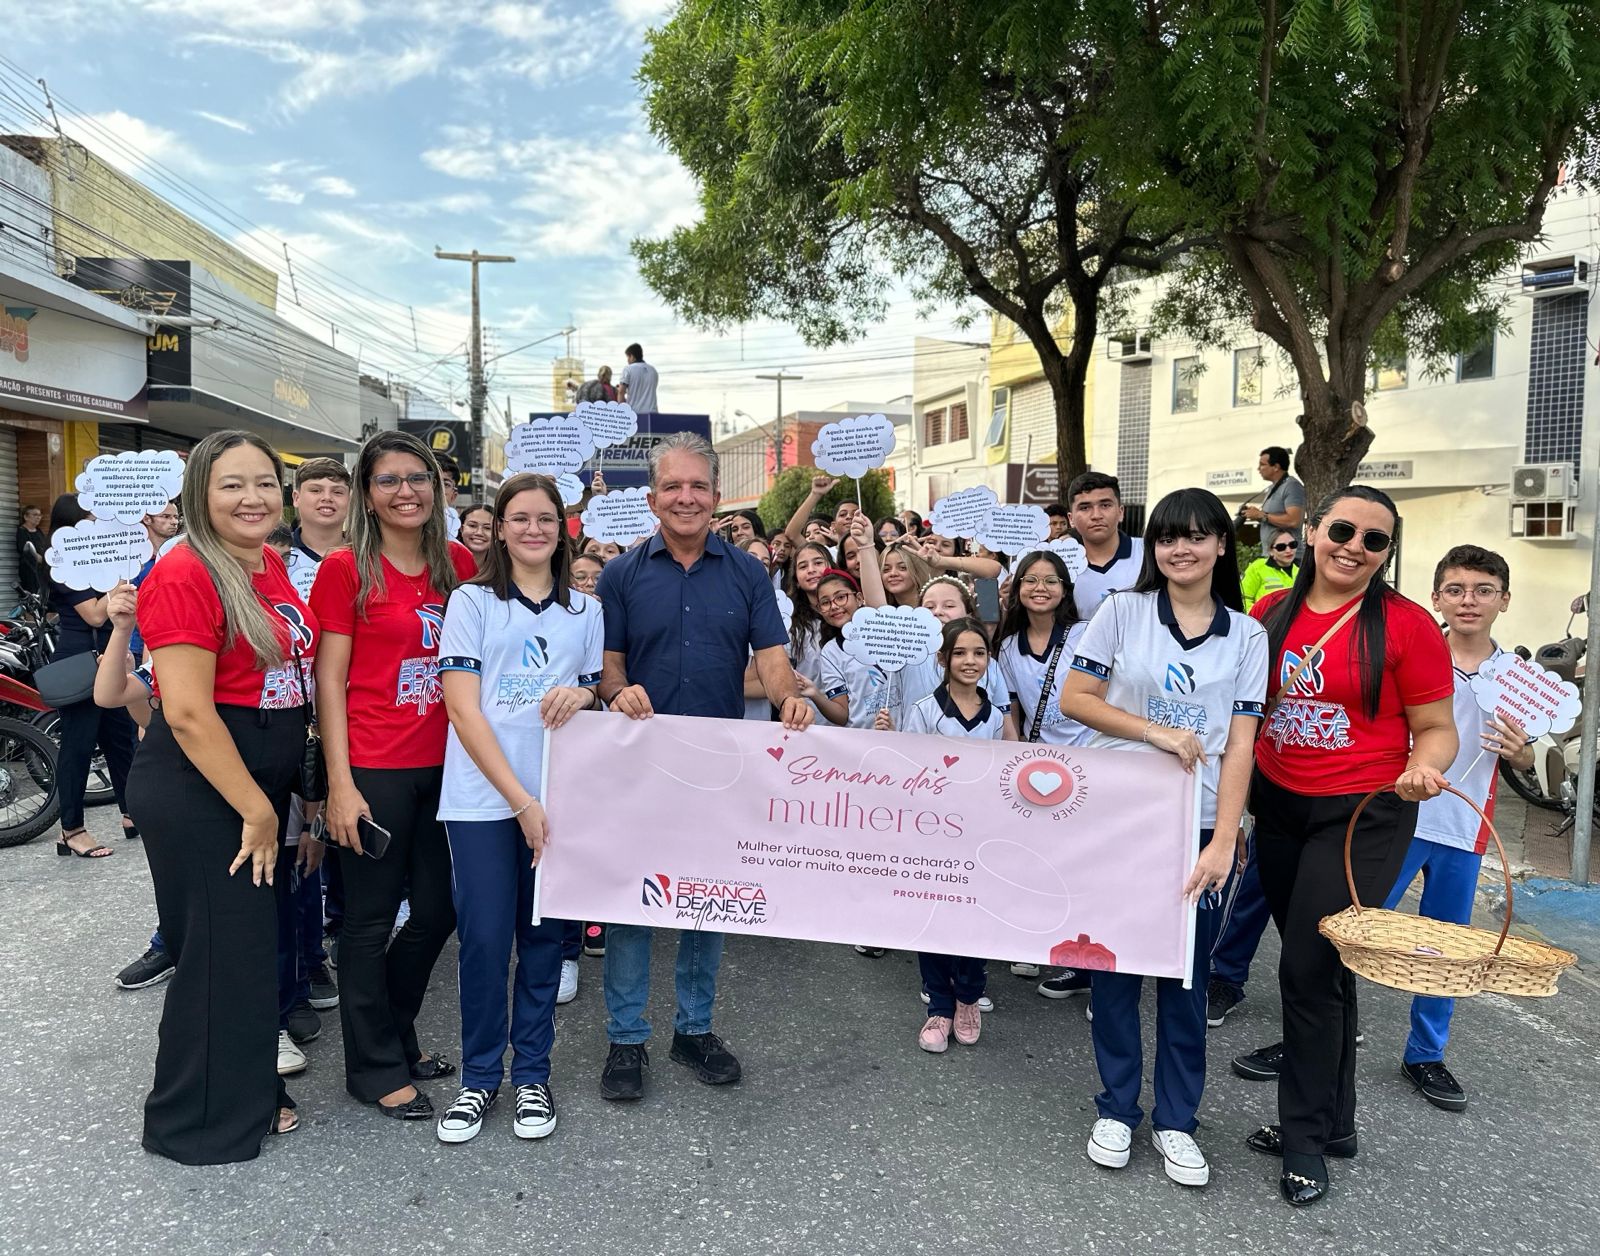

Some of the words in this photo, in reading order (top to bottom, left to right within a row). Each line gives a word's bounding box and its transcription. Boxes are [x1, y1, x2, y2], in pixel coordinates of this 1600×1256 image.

[26, 385, 61, 399] PRESENTES
[66, 393, 82, 403] LISTA
[84, 396, 90, 405] DE
[92, 398, 123, 410] CASAMENTO
[91, 540, 127, 549] preparada
[400, 662, 440, 681] BRA
[500, 678, 559, 687] BRANCA
[1514, 656, 1536, 676] Toda
[1536, 673, 1570, 698] mulher
[522, 688, 550, 697] NEV
[1038, 699, 1047, 725] YOUNG
[1043, 668, 1054, 696] FOREVER
[1052, 647, 1061, 667] YOUNG
[1495, 674, 1519, 694] força
[1519, 692, 1545, 711] capaz
[1545, 710, 1558, 720] de
[1506, 669, 1539, 693] guarda
[1539, 690, 1560, 707] uma
[1148, 698, 1207, 719] BRANCA
[1499, 693, 1530, 716] mudar
[1170, 713, 1207, 729] NEVE
[1292, 717, 1349, 739] NEVE
[787, 755, 897, 786] Semana
[902, 766, 952, 796] das
[1000, 748, 1072, 800] INTERNACIONAL
[1072, 765, 1086, 782] DA
[1012, 801, 1033, 818] DIA
[1051, 785, 1088, 820] MULHER
[767, 791, 964, 839] mulheres
[737, 840, 783, 853] Mulher
[786, 844, 843, 860] virtuosa,
[846, 851, 886, 864] quem
[890, 854, 899, 864] a
[903, 856, 960, 871] achará?
[963, 860, 975, 871] O
[741, 854, 765, 866] seu
[768, 856, 802, 869] valor
[805, 860, 845, 873] muito
[848, 865, 897, 878] excede
[901, 869, 910, 879] o
[913, 870, 932, 881] de
[935, 873, 969, 885] rubis
[677, 882, 767, 901] BRANCA
[678, 876, 714, 884] INSTITUTO
[715, 879, 763, 888] EDUCACIONAL
[676, 895, 704, 910] DE
[711, 897, 767, 916] NEVE
[893, 888, 962, 903] PROVÉRBIOS
[966, 896, 977, 905] 31
[676, 901, 767, 930] millennium
